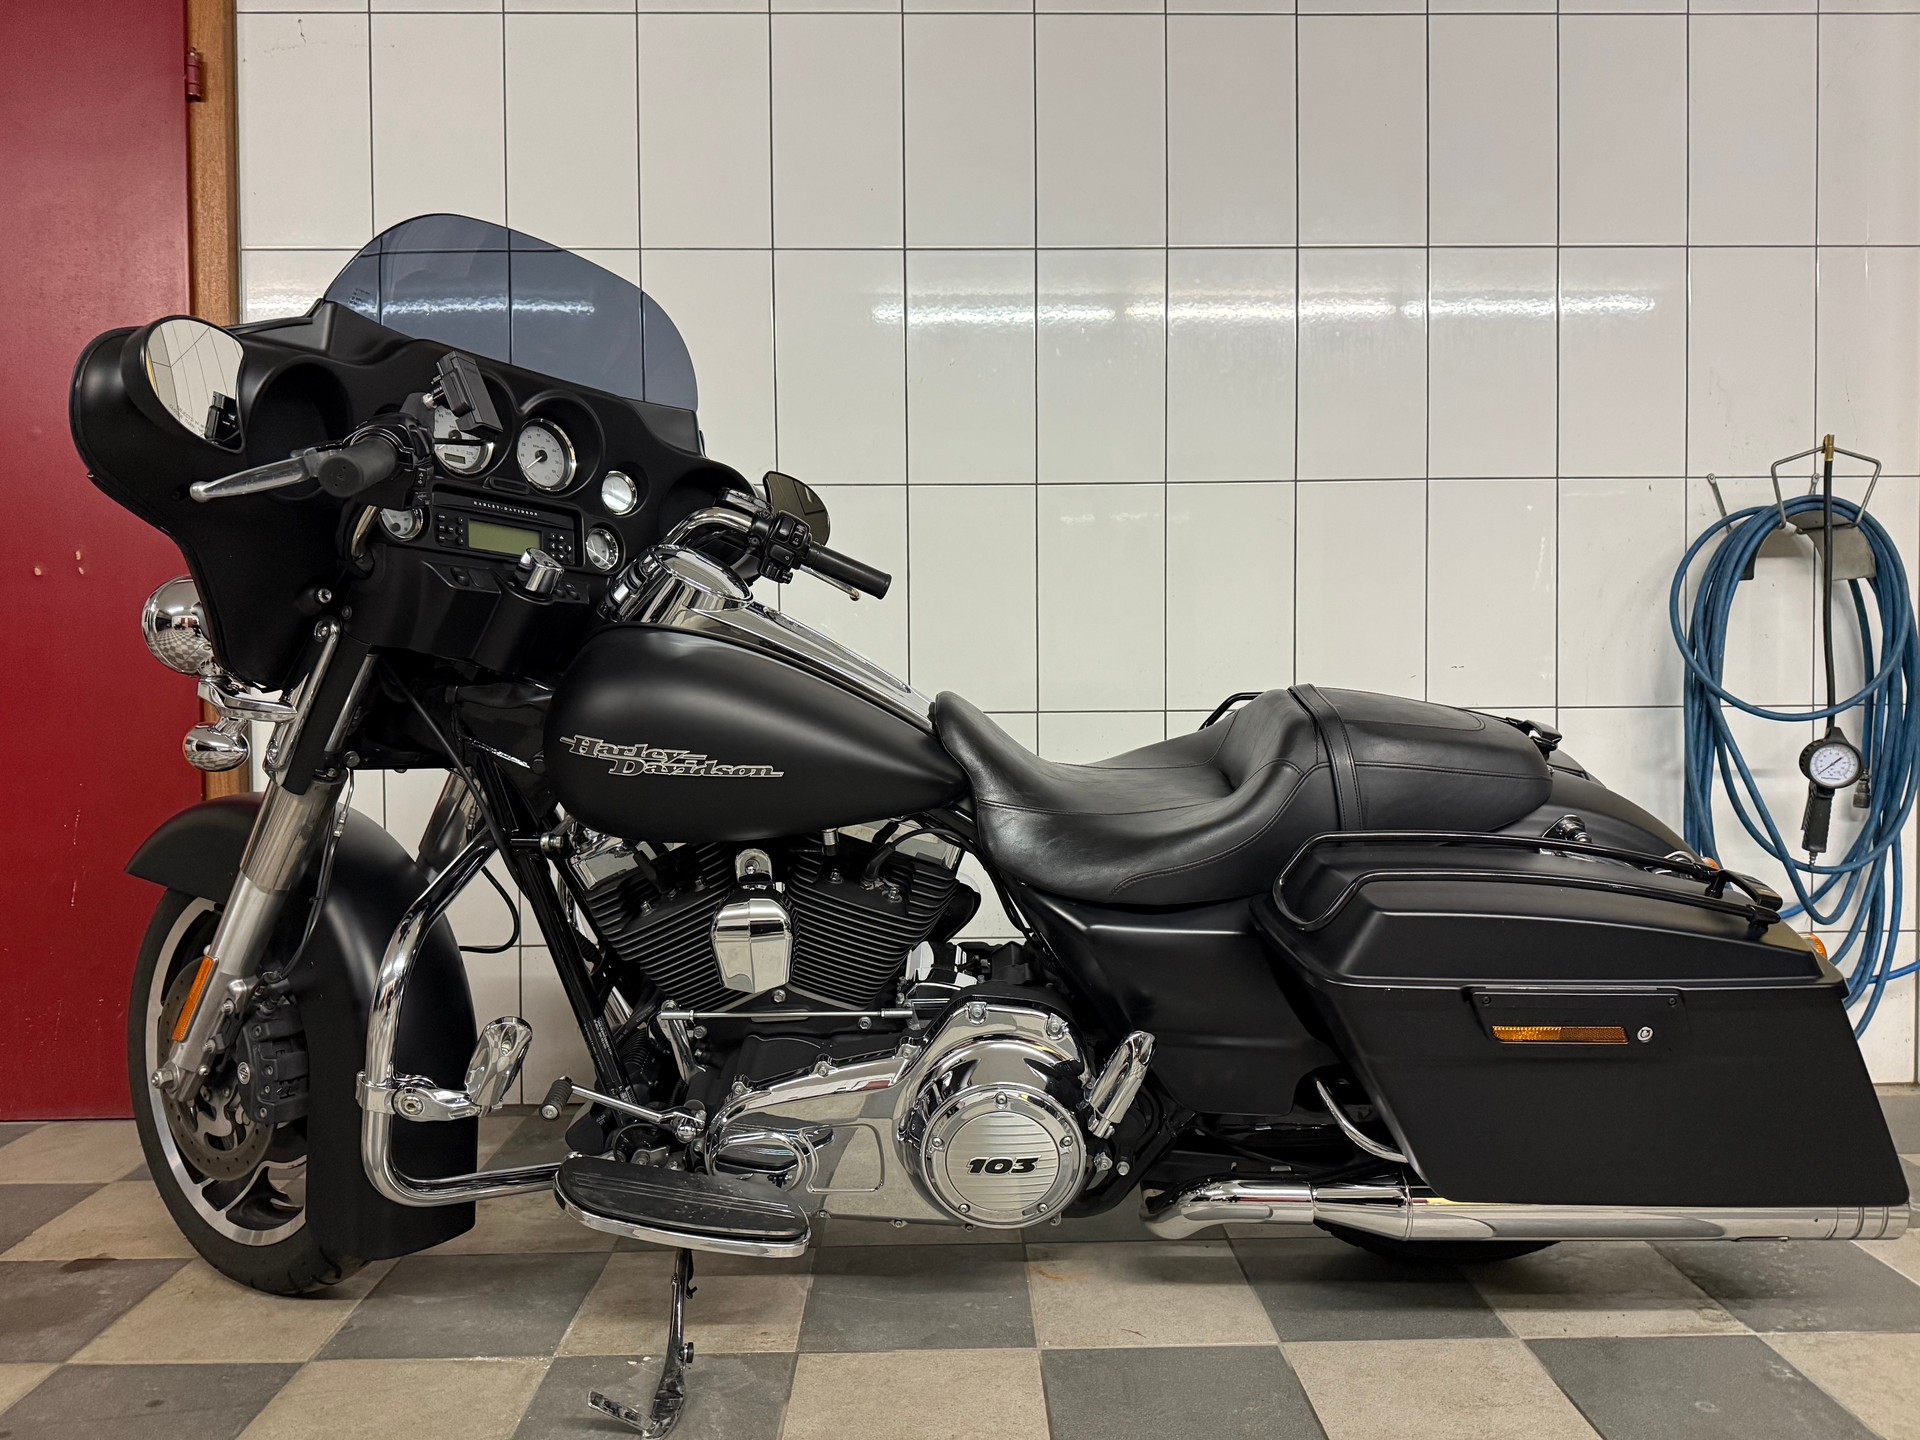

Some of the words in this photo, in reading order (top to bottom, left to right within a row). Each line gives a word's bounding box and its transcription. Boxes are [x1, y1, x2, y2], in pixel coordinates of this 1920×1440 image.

[560, 734, 708, 764] Harley
[602, 756, 784, 777] Davidson
[967, 1155, 1041, 1175] 103
